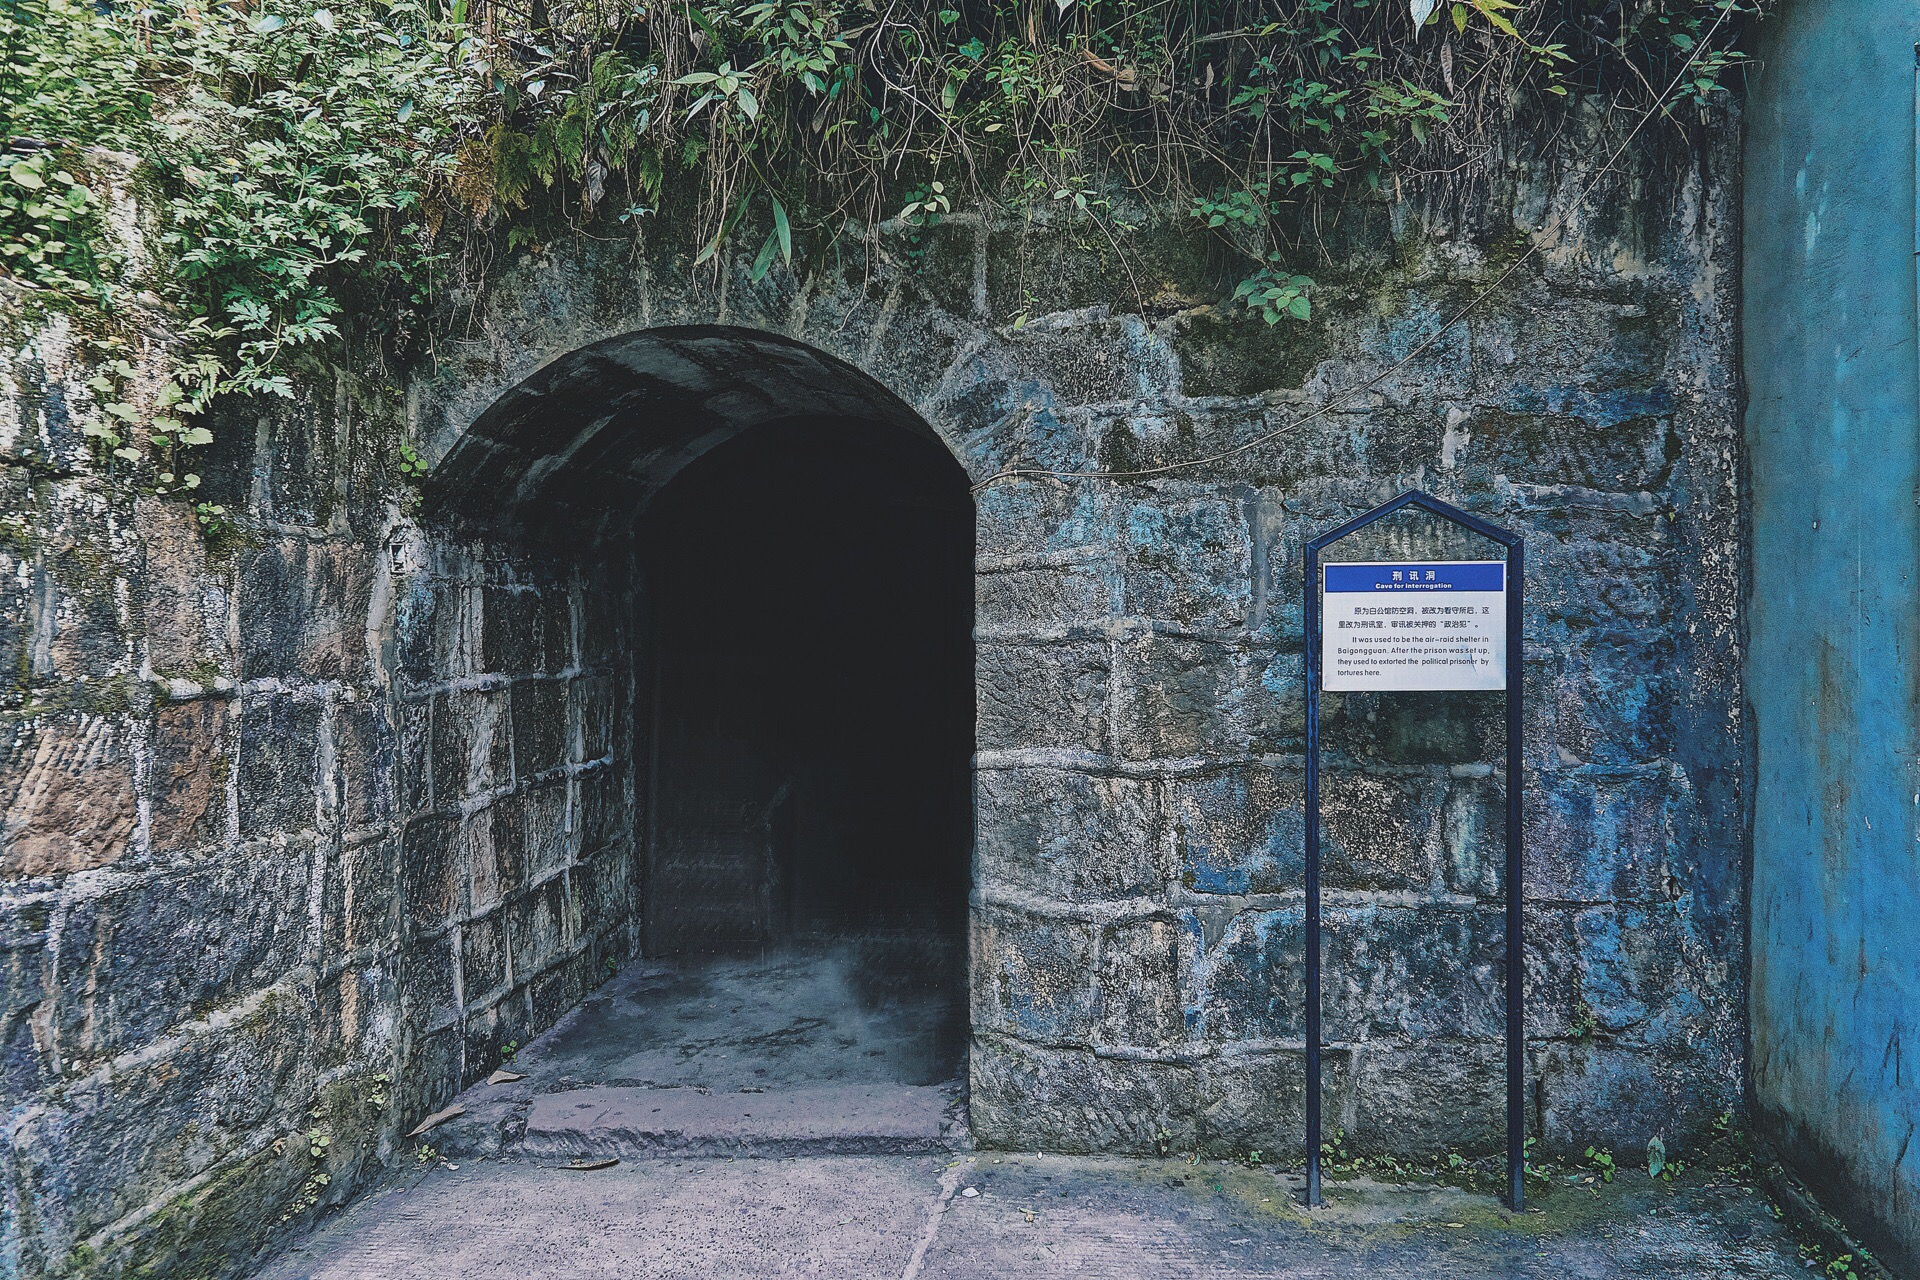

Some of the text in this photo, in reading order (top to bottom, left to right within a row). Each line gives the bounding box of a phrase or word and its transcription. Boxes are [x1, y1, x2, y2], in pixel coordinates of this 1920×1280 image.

[1392, 570, 1436, 581] 刑讯洞
[1337, 647, 1390, 656] Baigongguan.
[1423, 647, 1448, 655] prison
[1337, 658, 1353, 667] they
[1421, 658, 1449, 666] political
[1449, 658, 1478, 666] prisoner
[1480, 658, 1490, 667] by
